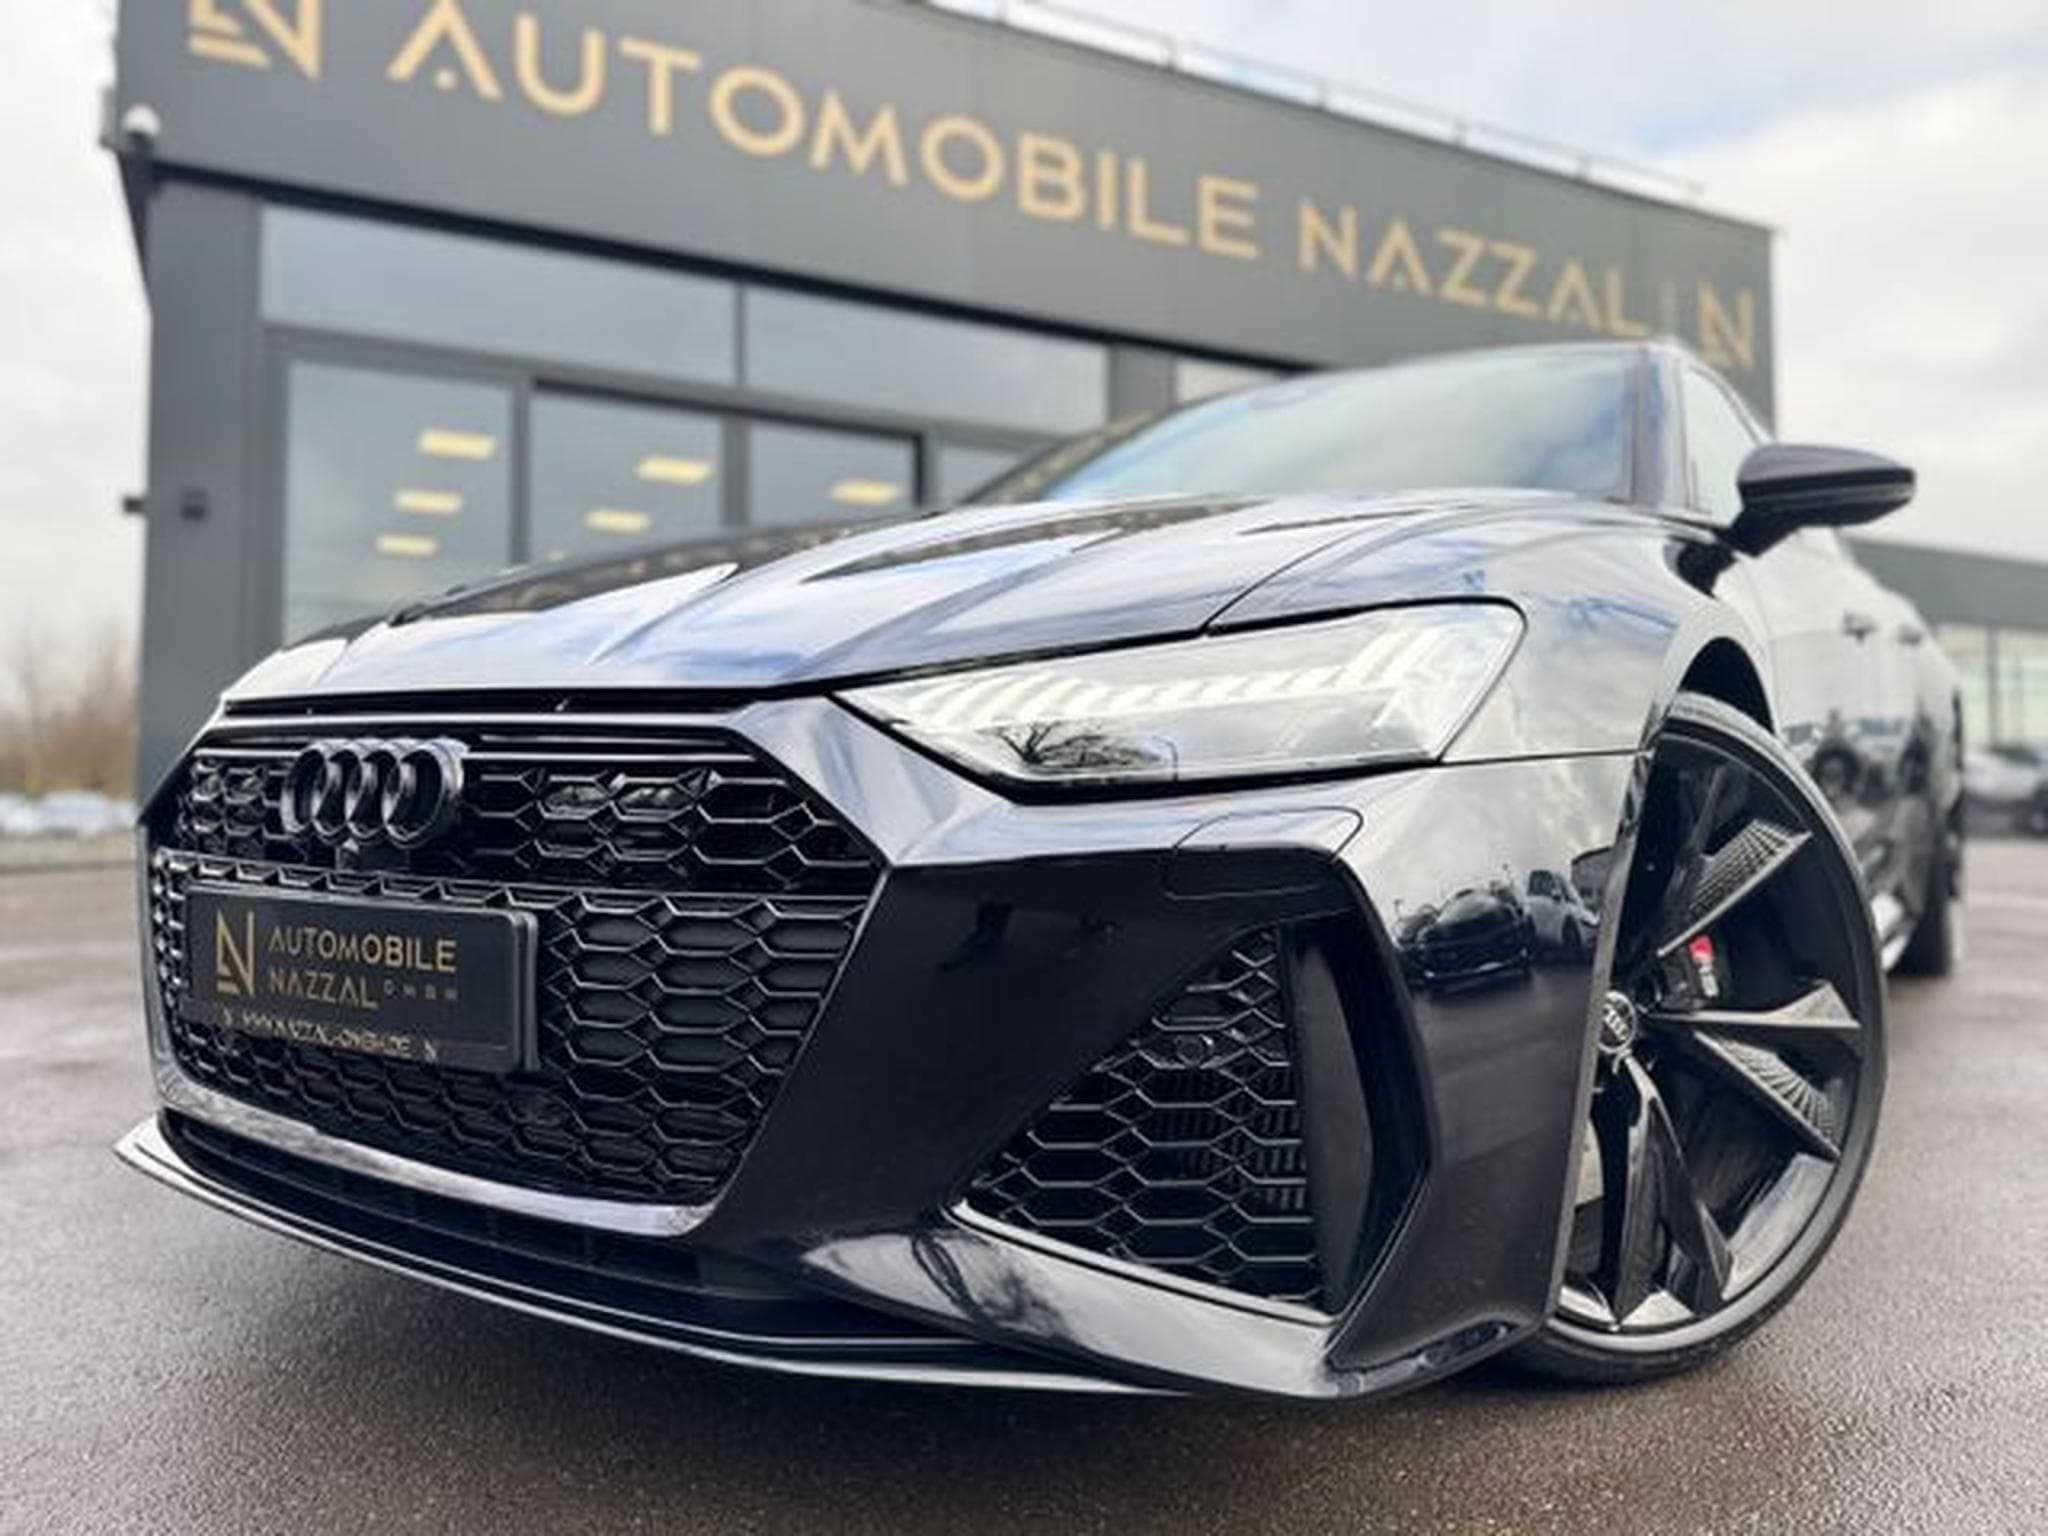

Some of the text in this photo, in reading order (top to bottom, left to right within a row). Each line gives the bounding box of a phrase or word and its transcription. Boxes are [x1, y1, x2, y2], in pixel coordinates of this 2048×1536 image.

[386, 0, 1260, 260] AUTOMOBILE
[1296, 198, 1650, 337] NAZZAL
[268, 924, 458, 972] AUTOMOBILE
[269, 970, 379, 1010] NAZZAL
